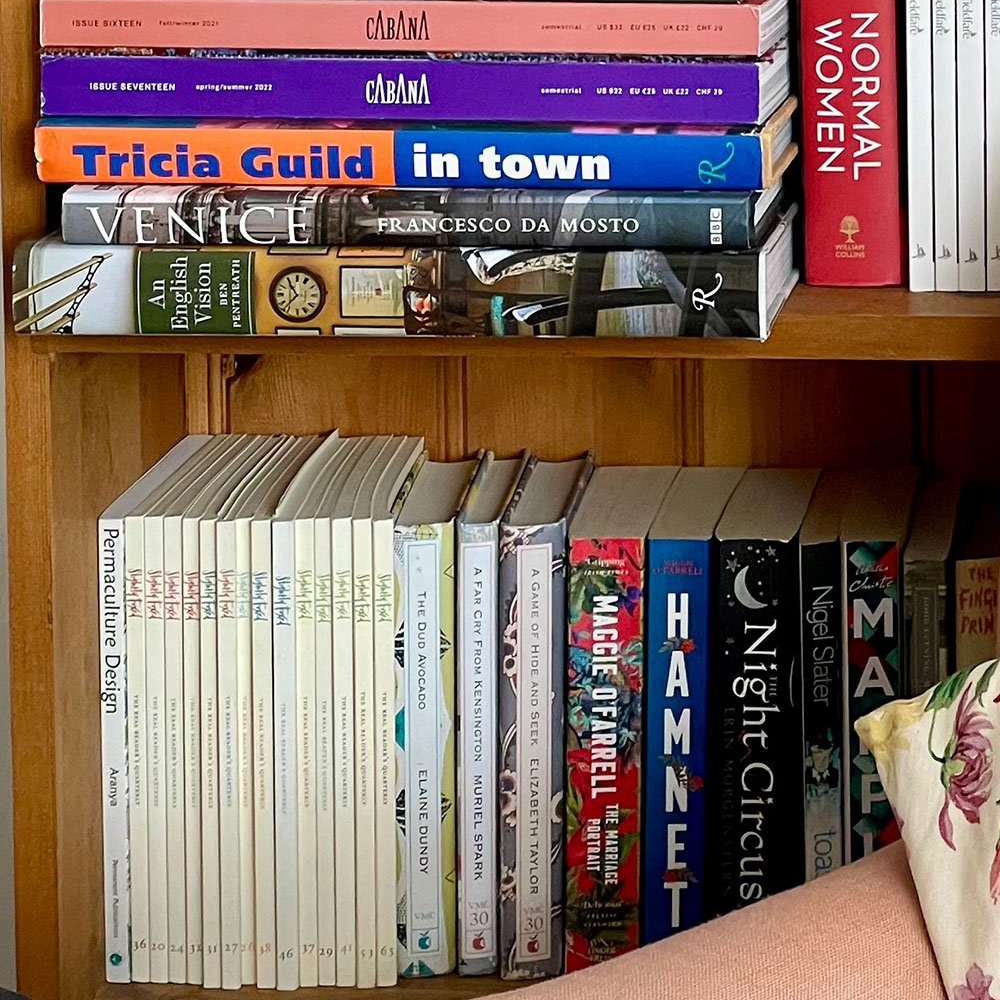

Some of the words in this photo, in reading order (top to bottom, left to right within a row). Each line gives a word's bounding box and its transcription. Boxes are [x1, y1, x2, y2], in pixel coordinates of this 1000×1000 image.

[366, 10, 430, 41] CABANA
[90, 83, 117, 91] ISSUE
[121, 83, 175, 91] SEVENTEEN
[366, 72, 431, 105] CABANA
[815, 19, 845, 172] WOMEN
[851, 12, 881, 180] NORMAL
[73, 144, 220, 178] Tricia
[241, 146, 373, 179] Guild
[414, 144, 459, 178] in
[479, 146, 610, 180] town
[87, 206, 310, 245] VENICE
[378, 218, 511, 234] FRANCESCO
[561, 219, 640, 232] MOSTO
[171, 255, 189, 331] English
[195, 262, 212, 323] Vision
[233, 259, 241, 327] PENTREATH
[103, 528, 119, 647] Permaculture
[127, 569, 144, 597] Slightly
[128, 599, 144, 618] Foxed
[377, 574, 393, 602] Slightly
[378, 604, 393, 622] Foxed
[592, 596, 619, 674] MAGGIE
[813, 586, 833, 640] Nigel
[101, 654, 121, 714] Design
[733, 621, 780, 749] Night
[813, 647, 833, 706] Slater
[591, 687, 617, 798] O'FARRELL
[107, 768, 119, 807] Aranya
[417, 770, 428, 821] ELAINE
[474, 775, 483, 829] MURIEL
[529, 759, 539, 836] ELIZABETH
[606, 804, 619, 826] THE
[739, 762, 773, 900] Circus
[418, 826, 429, 875] DUNDY
[474, 834, 484, 881] SPARK
[530, 841, 539, 895] TAYLOR
[587, 819, 601, 871] PORTRAIT
[605, 831, 619, 884] MARRIAGE
